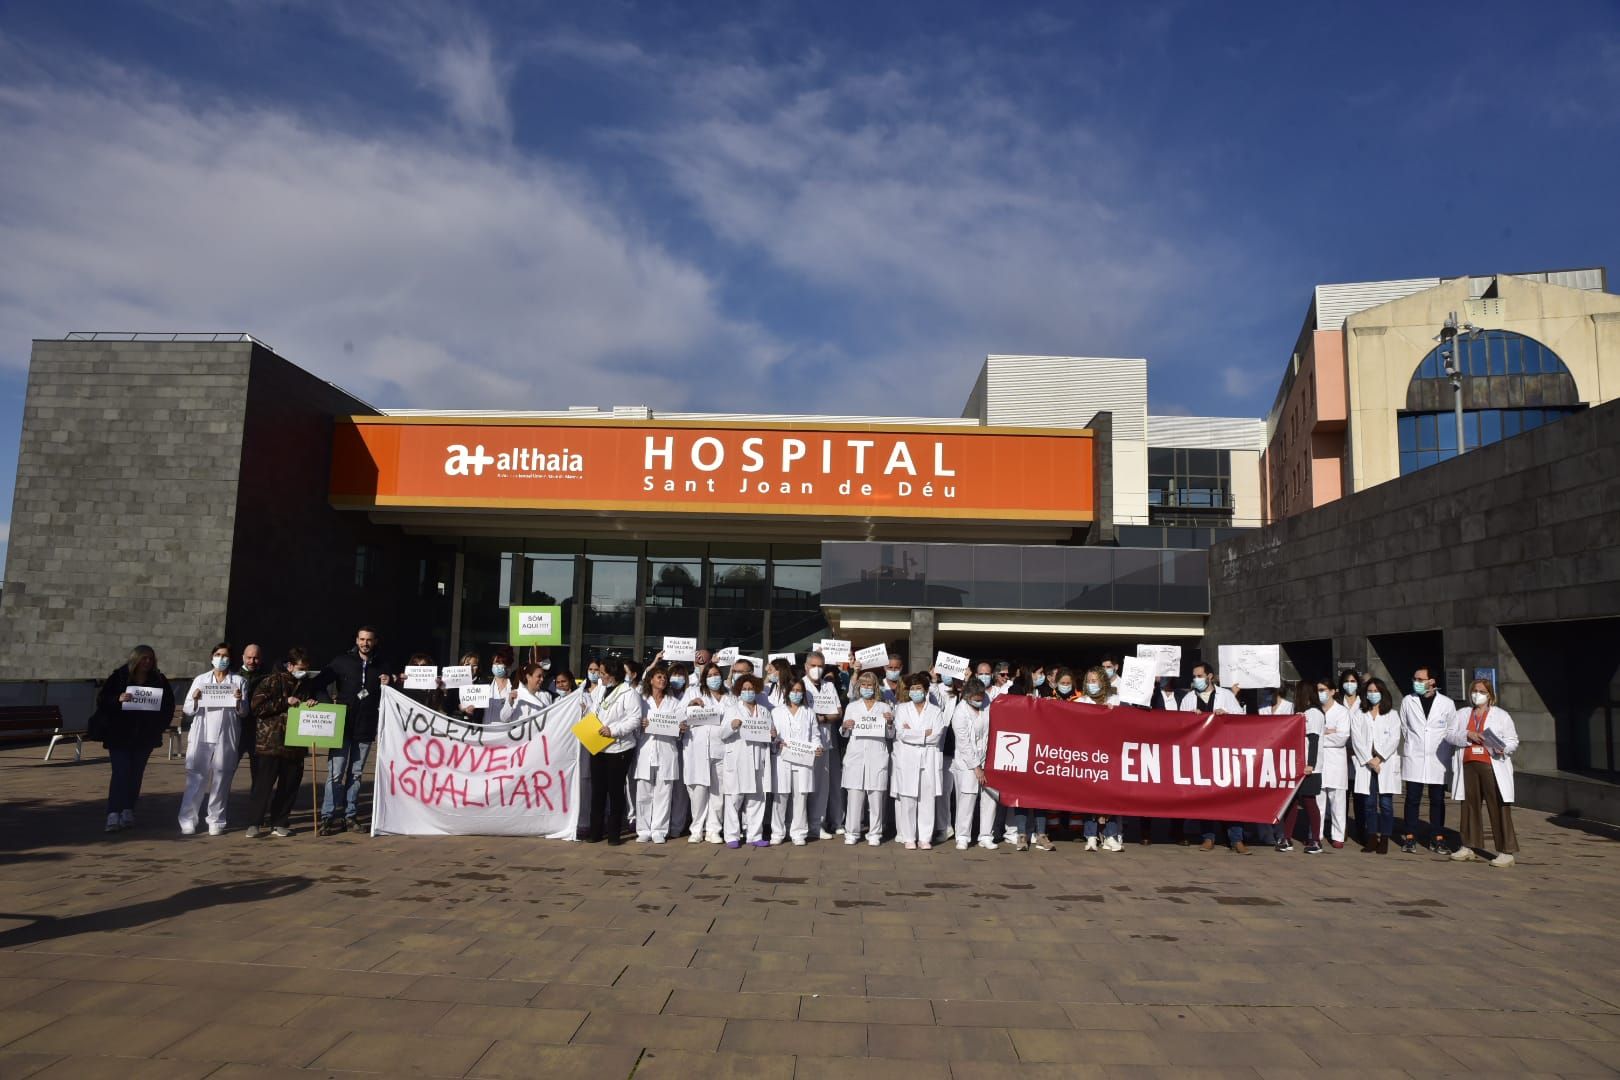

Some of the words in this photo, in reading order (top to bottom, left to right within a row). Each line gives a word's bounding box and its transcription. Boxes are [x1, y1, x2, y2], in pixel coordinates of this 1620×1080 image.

[496, 447, 583, 472] althaia
[644, 436, 955, 477] HOSPITAL
[643, 476, 715, 493] Sant
[739, 478, 814, 495] Joan
[838, 480, 872, 496] de
[898, 481, 955, 498] Déu
[396, 703, 484, 746] VOLEM
[508, 709, 548, 741] UN
[1035, 744, 1089, 764] Metges
[1091, 750, 1109, 764] de
[1121, 742, 1161, 784] EN
[389, 760, 568, 814] IGUALITARI
[1033, 761, 1109, 783] Catalunya
